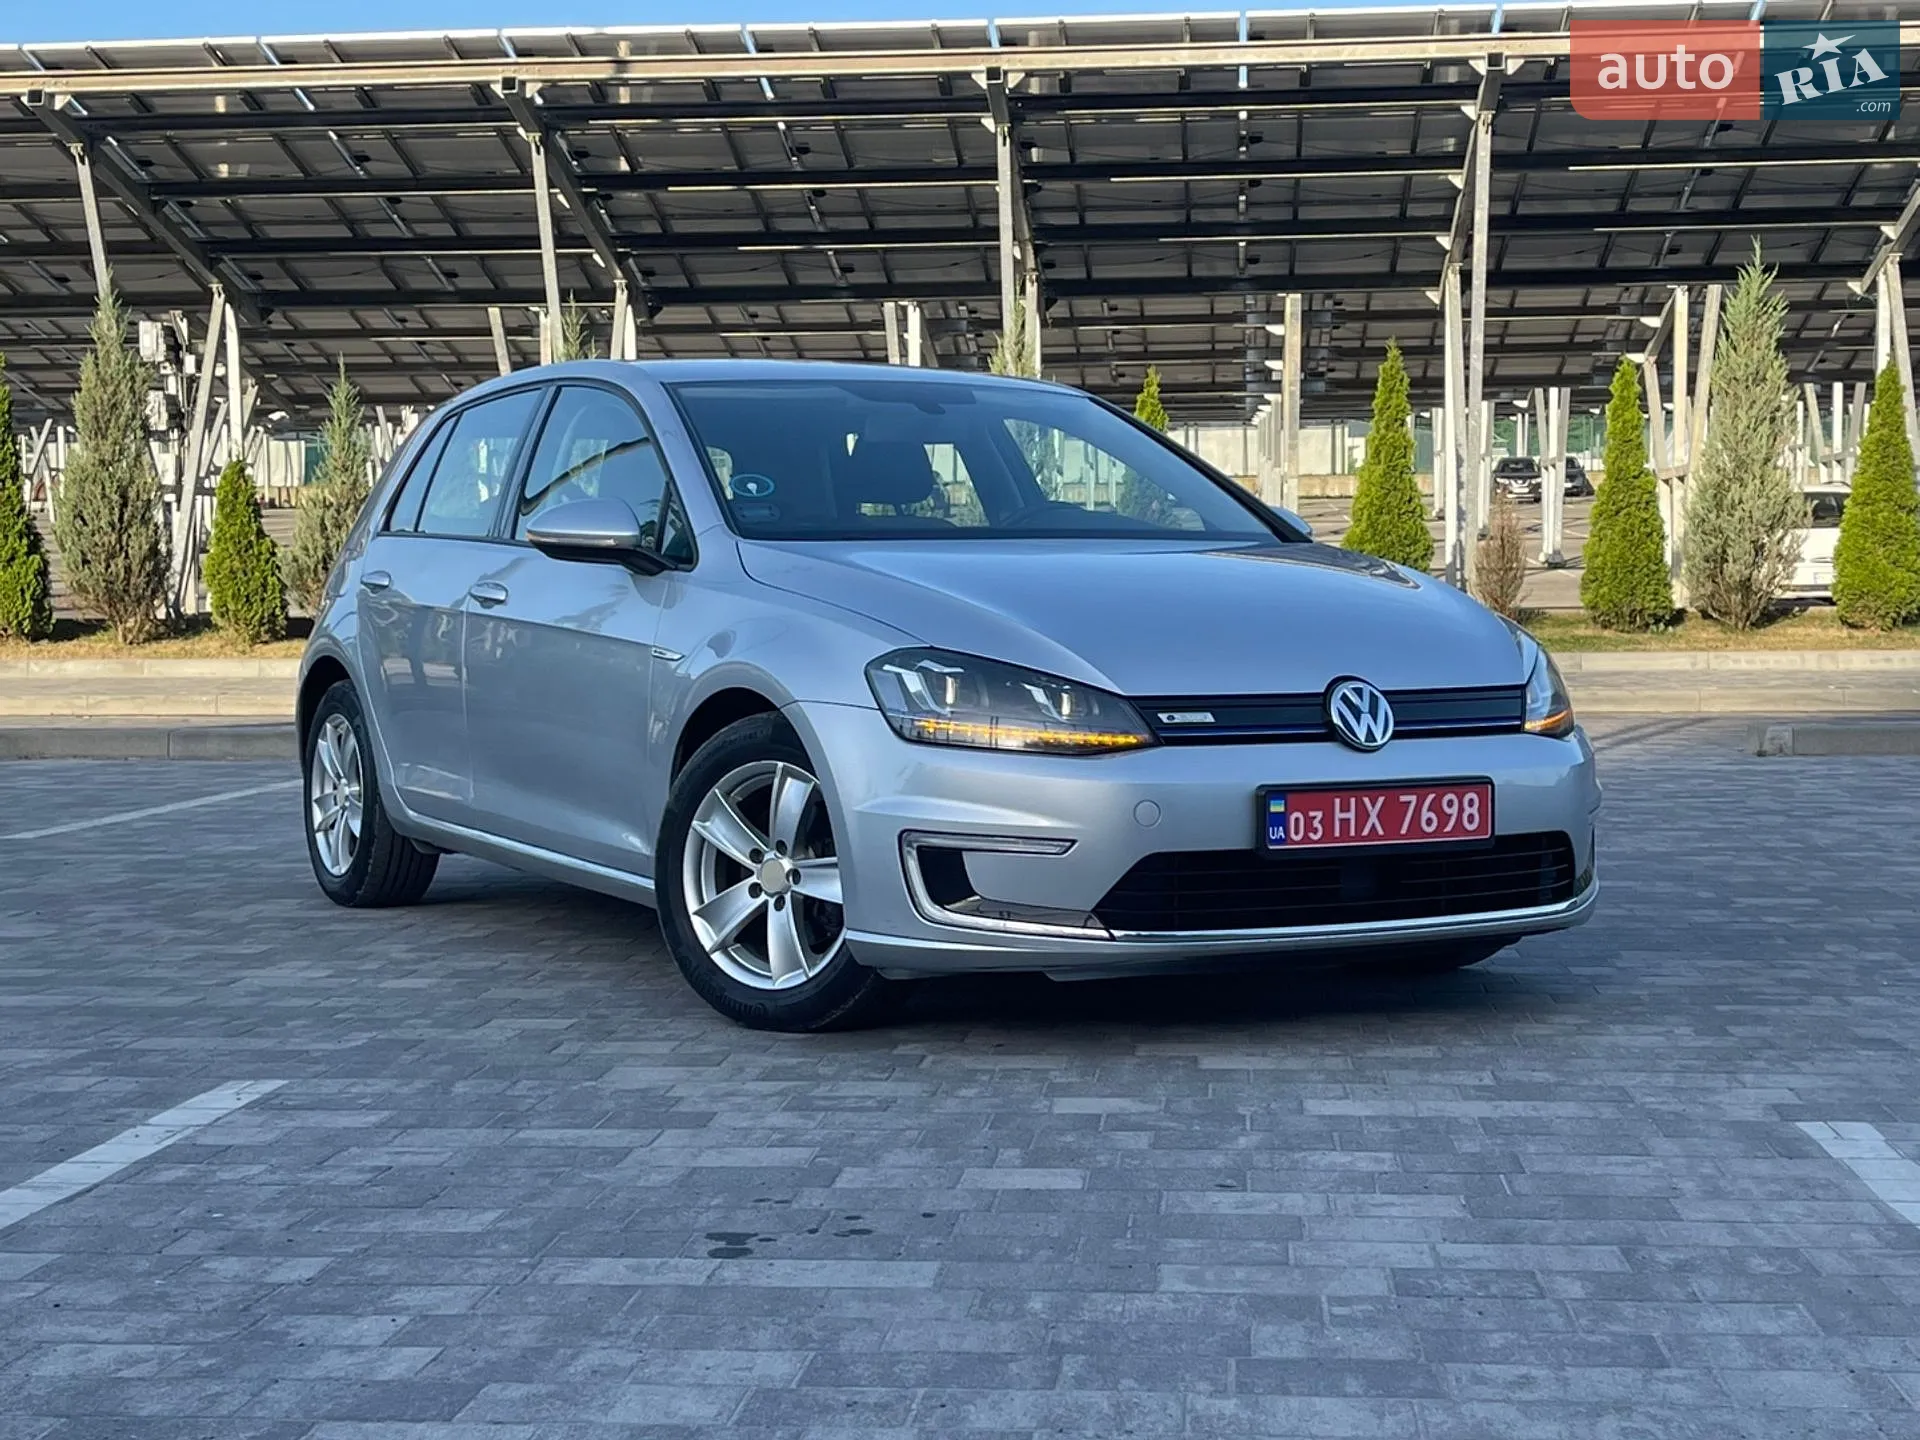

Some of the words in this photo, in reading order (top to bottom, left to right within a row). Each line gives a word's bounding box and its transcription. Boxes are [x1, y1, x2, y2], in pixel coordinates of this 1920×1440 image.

[1269, 826, 1286, 840] UA
[1289, 811, 1324, 842] 03
[1333, 796, 1386, 837] HX
[1399, 792, 1481, 835] 7698
